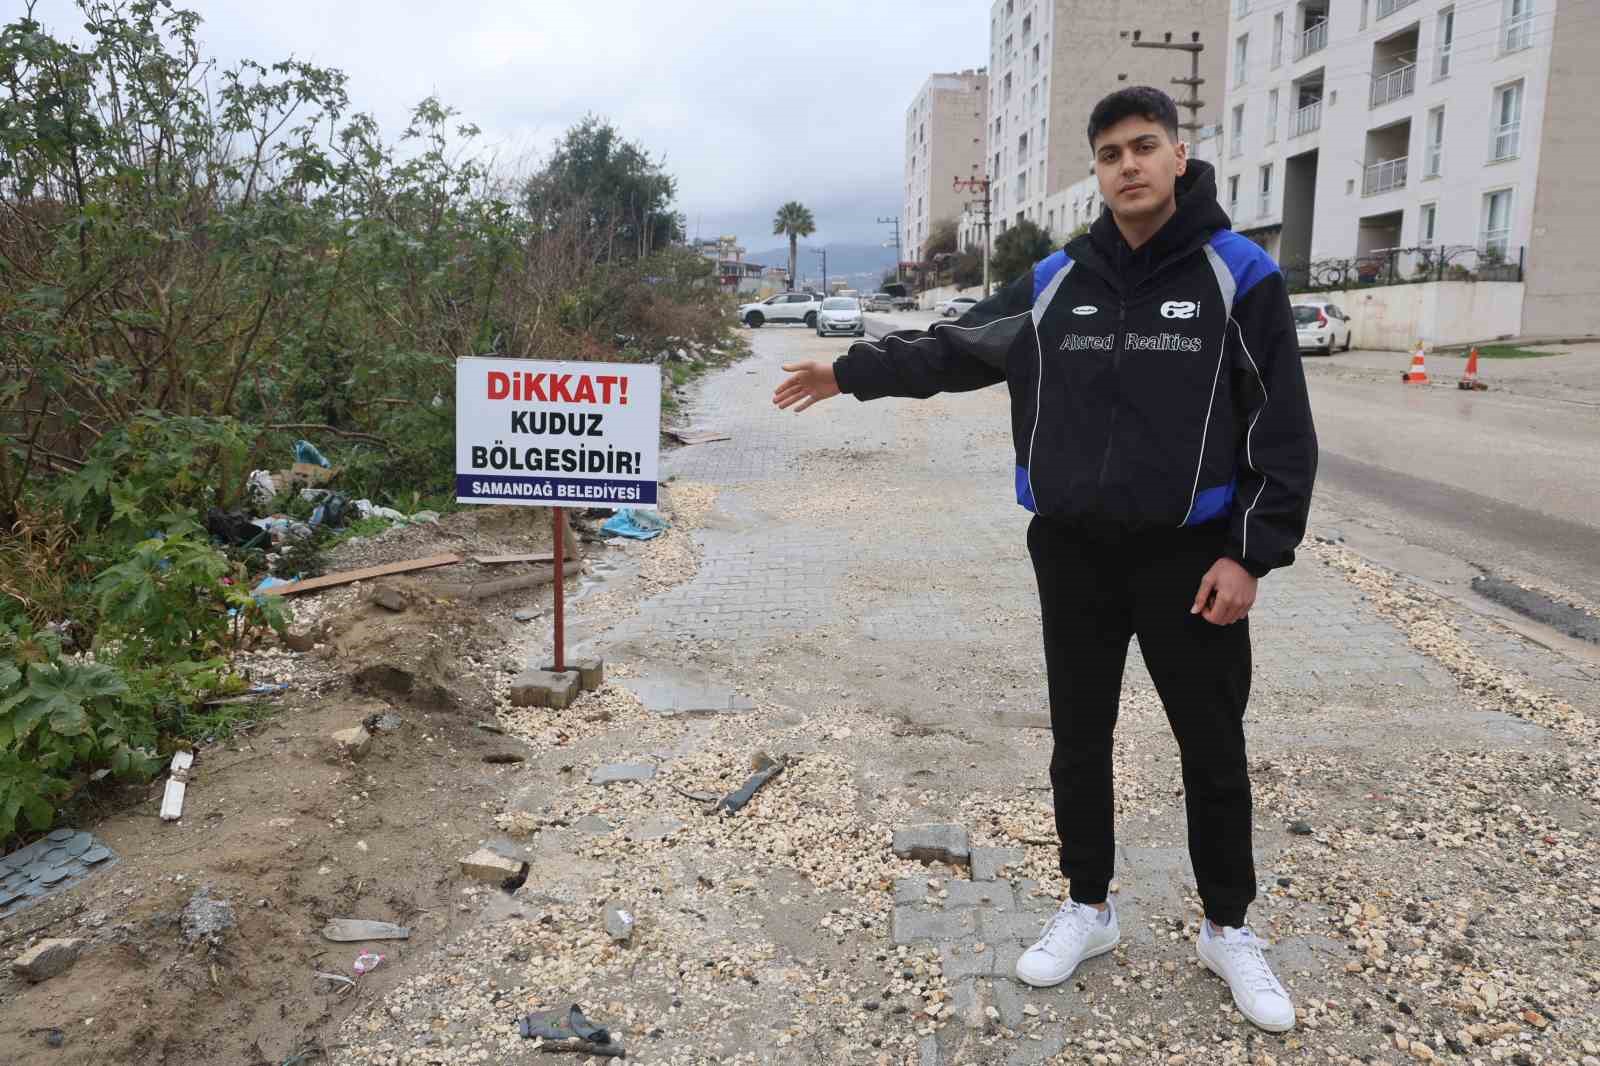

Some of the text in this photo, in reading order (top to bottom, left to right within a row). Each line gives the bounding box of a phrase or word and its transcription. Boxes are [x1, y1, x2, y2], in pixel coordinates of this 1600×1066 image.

[1060, 333, 1202, 351] Altered Realities
[511, 411, 603, 437] KUDUZ
[471, 440, 641, 475] BÖLGESİDİR!
[472, 481, 640, 500] SAMANDAĞ BELEDİYESİ
